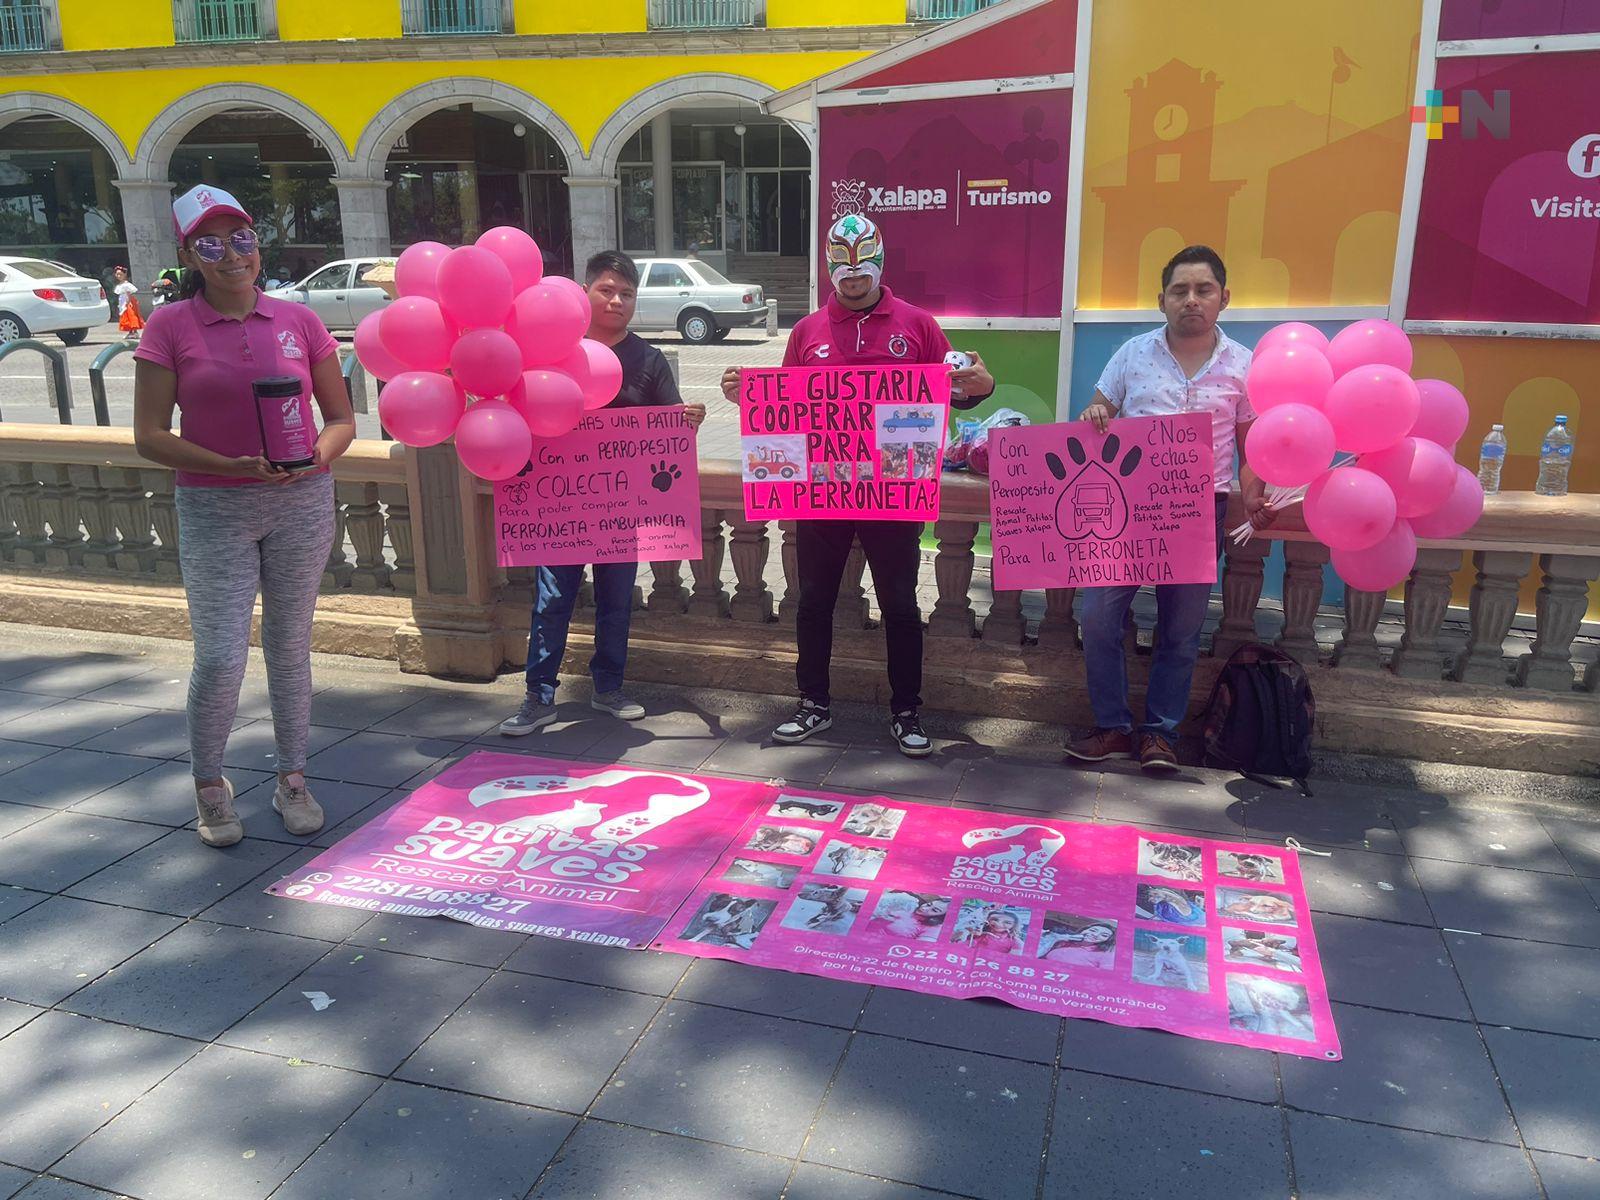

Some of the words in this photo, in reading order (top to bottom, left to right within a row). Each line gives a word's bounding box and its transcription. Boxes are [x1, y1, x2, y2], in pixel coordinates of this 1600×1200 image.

[867, 186, 947, 210] Xalapa
[967, 187, 1052, 206] Turismo
[875, 205, 917, 213] Ayuntamiento
[807, 370, 934, 403] GUSTARIA
[611, 415, 639, 430] UNA
[749, 402, 873, 432] COOPERAR
[1148, 420, 1197, 446] ¿Nos
[539, 446, 565, 465] Con
[575, 454, 589, 463] un
[808, 432, 872, 462] PARA
[1000, 437, 1029, 459] Con
[1150, 447, 1199, 467] echas
[1008, 463, 1027, 477] un
[1161, 468, 1190, 481] una
[537, 471, 628, 498] COLECTA
[751, 483, 782, 509] LA
[794, 479, 938, 511] PERRONETA?
[992, 480, 1054, 500] Perropesito
[499, 504, 530, 517] Para
[538, 504, 573, 519] poder
[582, 501, 629, 513] comprar
[638, 496, 648, 507] la
[996, 506, 1026, 516] Rescate
[1133, 513, 1163, 522] Patitas
[1170, 511, 1201, 520] Suaves
[1134, 504, 1163, 512] Rescate
[1170, 501, 1195, 509] Animal
[501, 521, 588, 540] PERRONETA
[600, 514, 685, 531] AMBULANCIA
[995, 517, 1021, 528] Animal
[1025, 514, 1054, 523] Patitas
[997, 528, 1022, 538] Suaves
[502, 542, 516, 553] de
[521, 541, 536, 551] los
[998, 545, 1031, 565] Para
[1042, 542, 1056, 563] la
[1064, 538, 1169, 561] PERRONETA
[1068, 561, 1174, 584] AMBULANCIA
[370, 857, 499, 887] Rescate
[502, 876, 618, 902] Animal
[947, 881, 1002, 894] Rescate
[1005, 889, 1053, 902] Animal
[314, 889, 381, 909] Rescate
[505, 919, 565, 937] suaves
[567, 930, 631, 947] xalapa
[794, 945, 860, 962] Dirección:
[863, 957, 879, 965] 22
[881, 959, 899, 968] de
[902, 962, 952, 976] febrero
[998, 976, 1037, 991] Loma
[1042, 985, 1092, 1000] Bonita,
[1096, 995, 1167, 1011] entrando
[913, 950, 938, 960] 22
[946, 953, 967, 966] 81
[975, 958, 1000, 970] 26
[1007, 966, 1036, 978] 88
[1043, 971, 1070, 983] 27
[823, 961, 847, 970] por
[850, 964, 861, 973] la
[865, 967, 916, 981] Colonia
[919, 975, 934, 983] 21
[936, 978, 954, 987] de
[1008, 988, 1057, 1004] Xalapa
[1061, 998, 1130, 1016] Veracruz.
